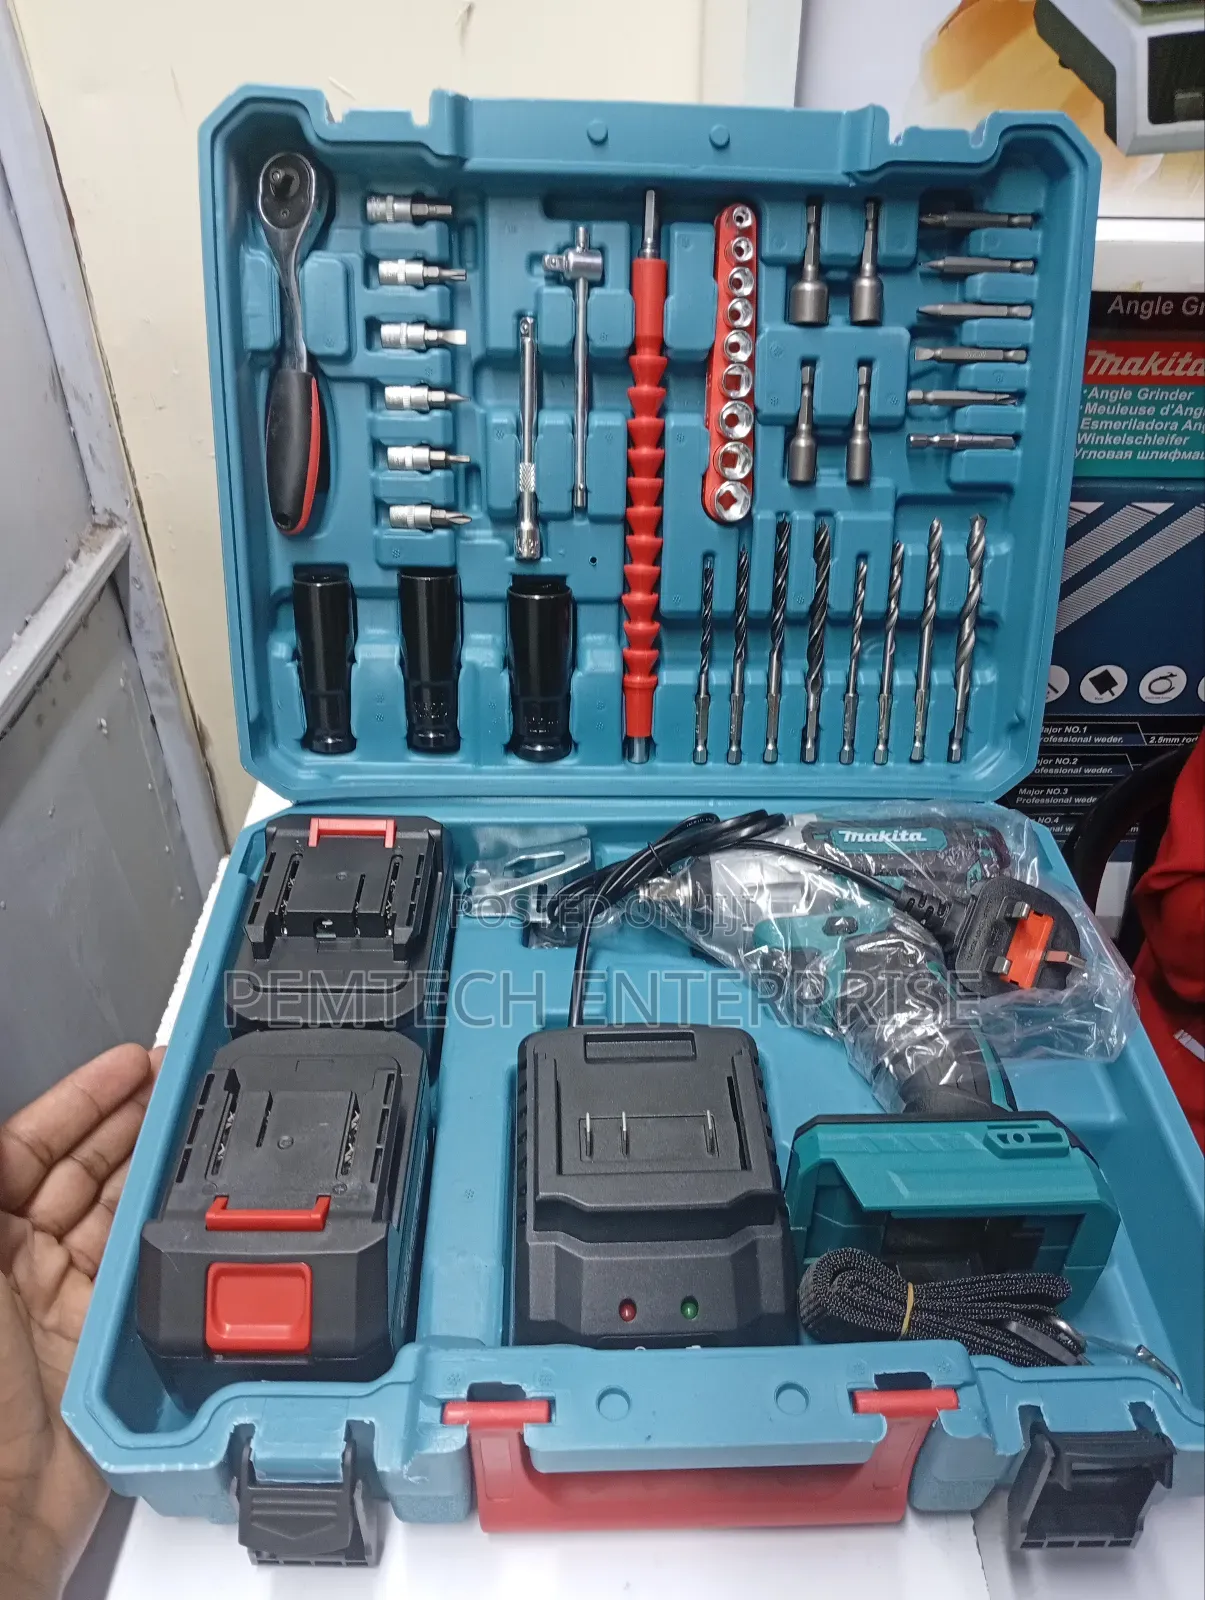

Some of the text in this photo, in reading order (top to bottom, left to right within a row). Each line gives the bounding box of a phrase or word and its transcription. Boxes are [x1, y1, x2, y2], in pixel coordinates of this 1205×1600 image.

[1107, 294, 1174, 320] Angle
[1087, 387, 1195, 402] Angle Grinder
[1084, 402, 1155, 416] Meuleuse
[1077, 433, 1190, 446] Winkelschleifer
[1019, 788, 1044, 796] Major
